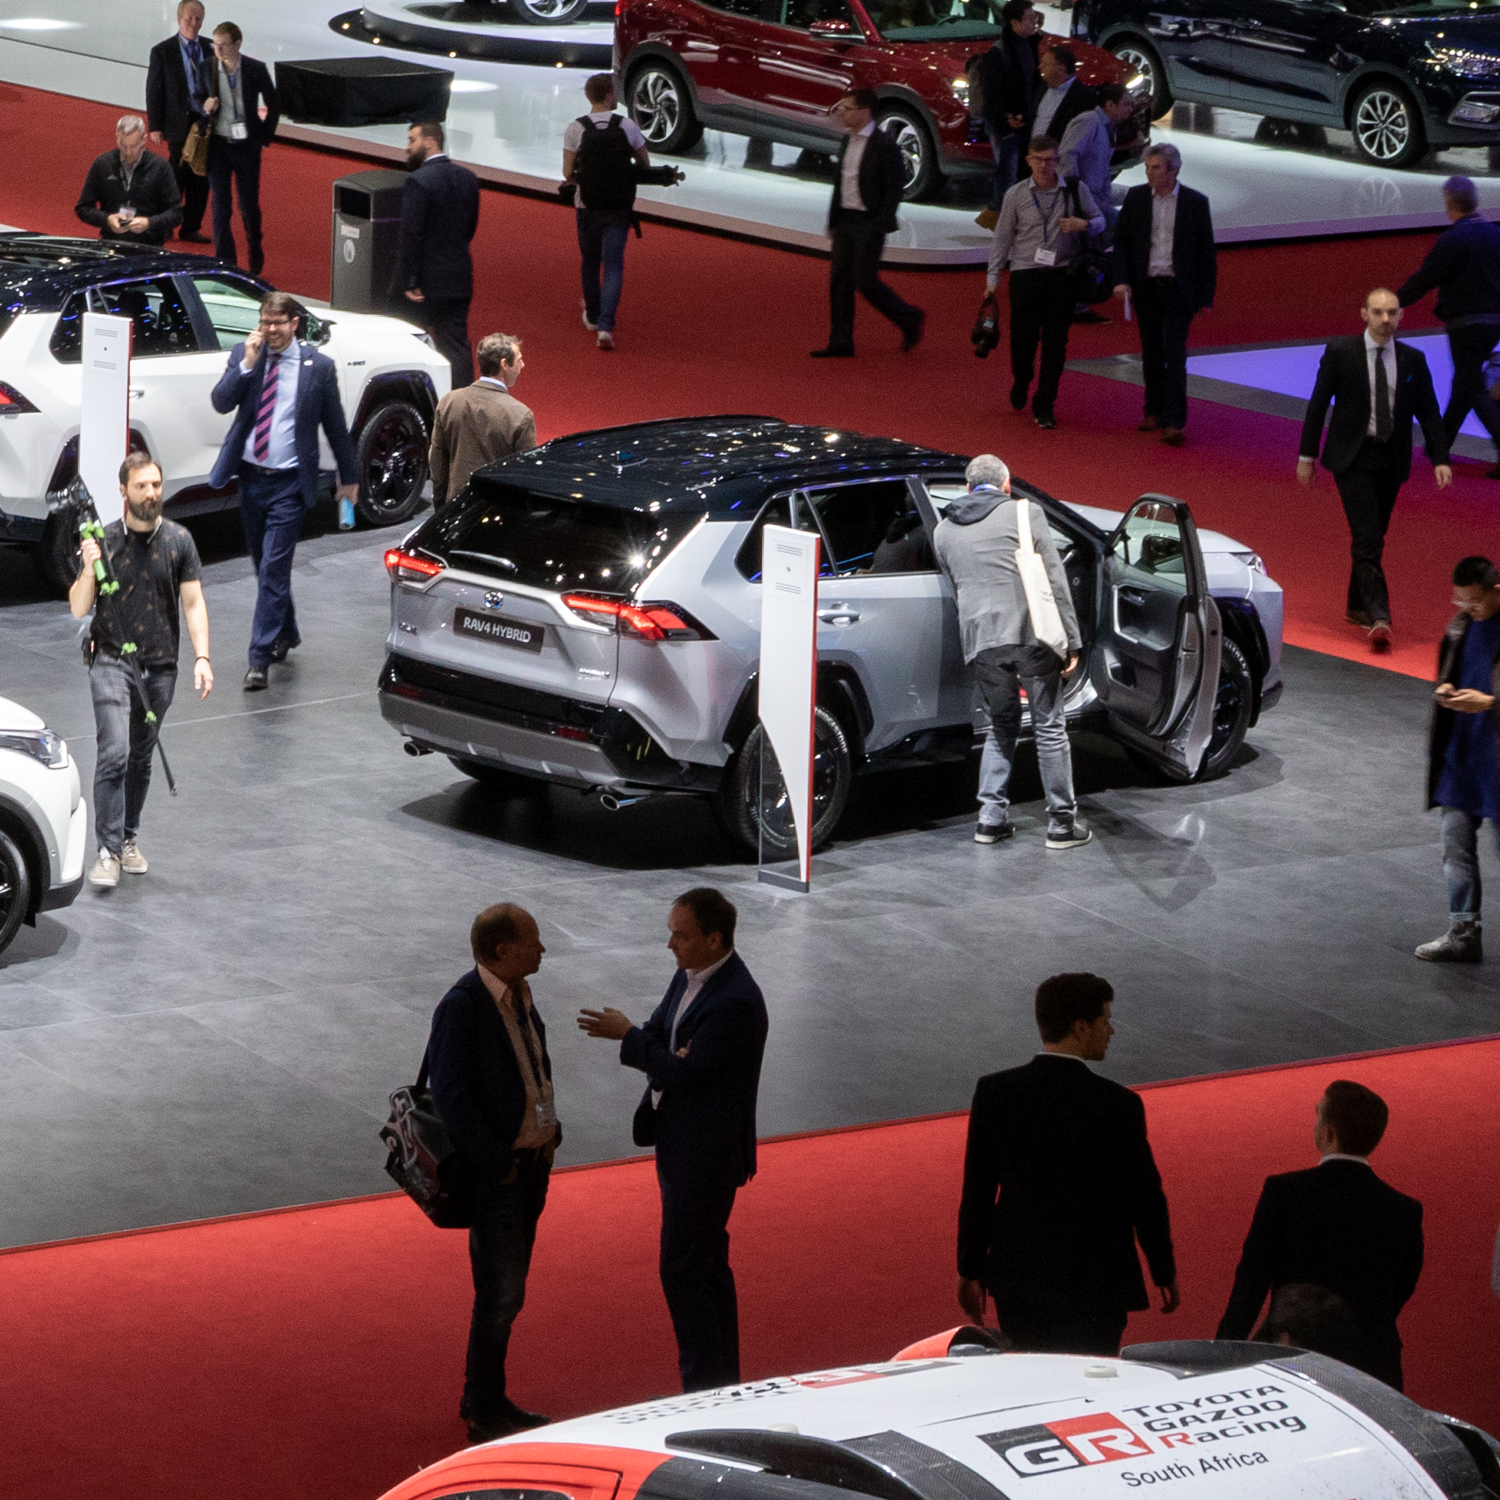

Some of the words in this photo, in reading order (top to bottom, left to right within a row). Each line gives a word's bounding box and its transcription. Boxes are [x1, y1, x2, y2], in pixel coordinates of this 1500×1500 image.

[462, 616, 492, 634] RAV4
[491, 623, 532, 644] HYBRID
[1121, 1384, 1286, 1418] TOYOTA
[1143, 1398, 1290, 1434] GAZOO
[998, 1422, 1155, 1477] GR
[1157, 1415, 1308, 1450] Racing
[1121, 1463, 1196, 1488] South
[1201, 1448, 1270, 1477] Africa
